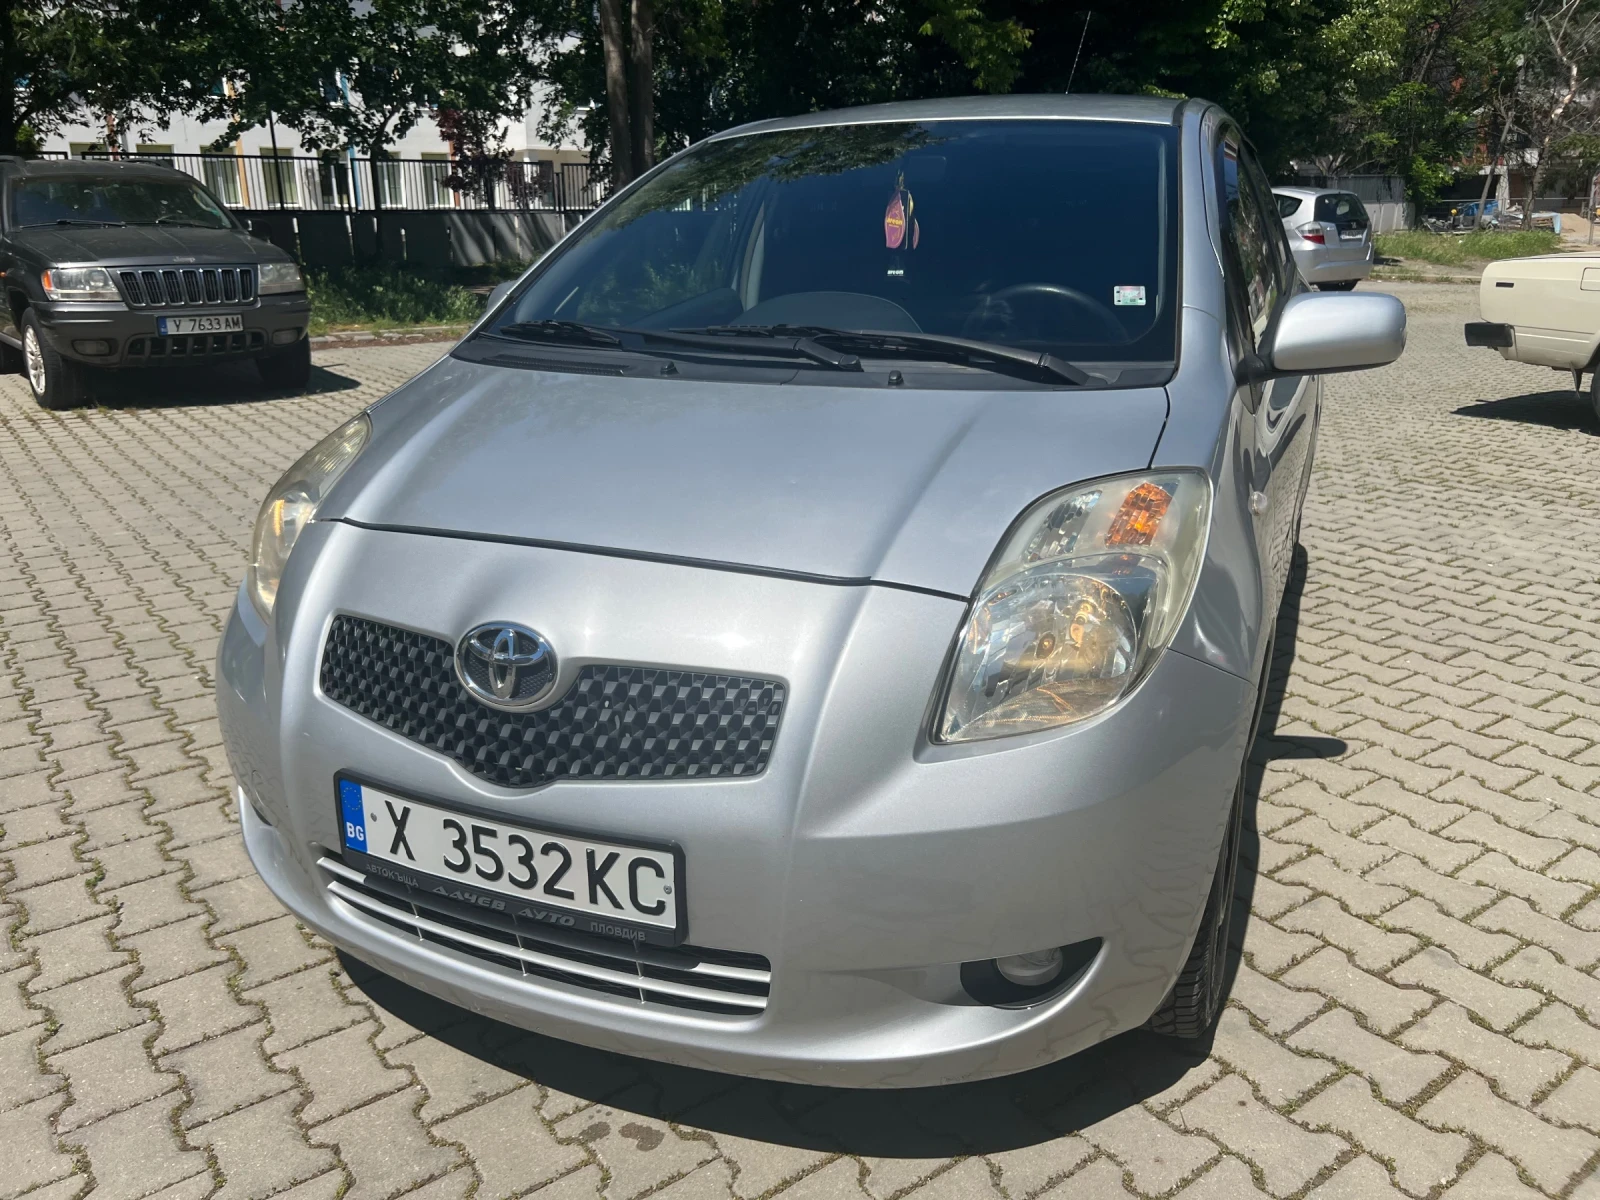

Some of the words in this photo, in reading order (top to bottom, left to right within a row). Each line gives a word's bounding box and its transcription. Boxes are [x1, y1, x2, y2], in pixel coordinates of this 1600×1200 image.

[189, 318, 222, 332] 7633
[346, 821, 365, 842] BG
[384, 800, 416, 862] X
[590, 922, 647, 942] ПЛОВДИВ
